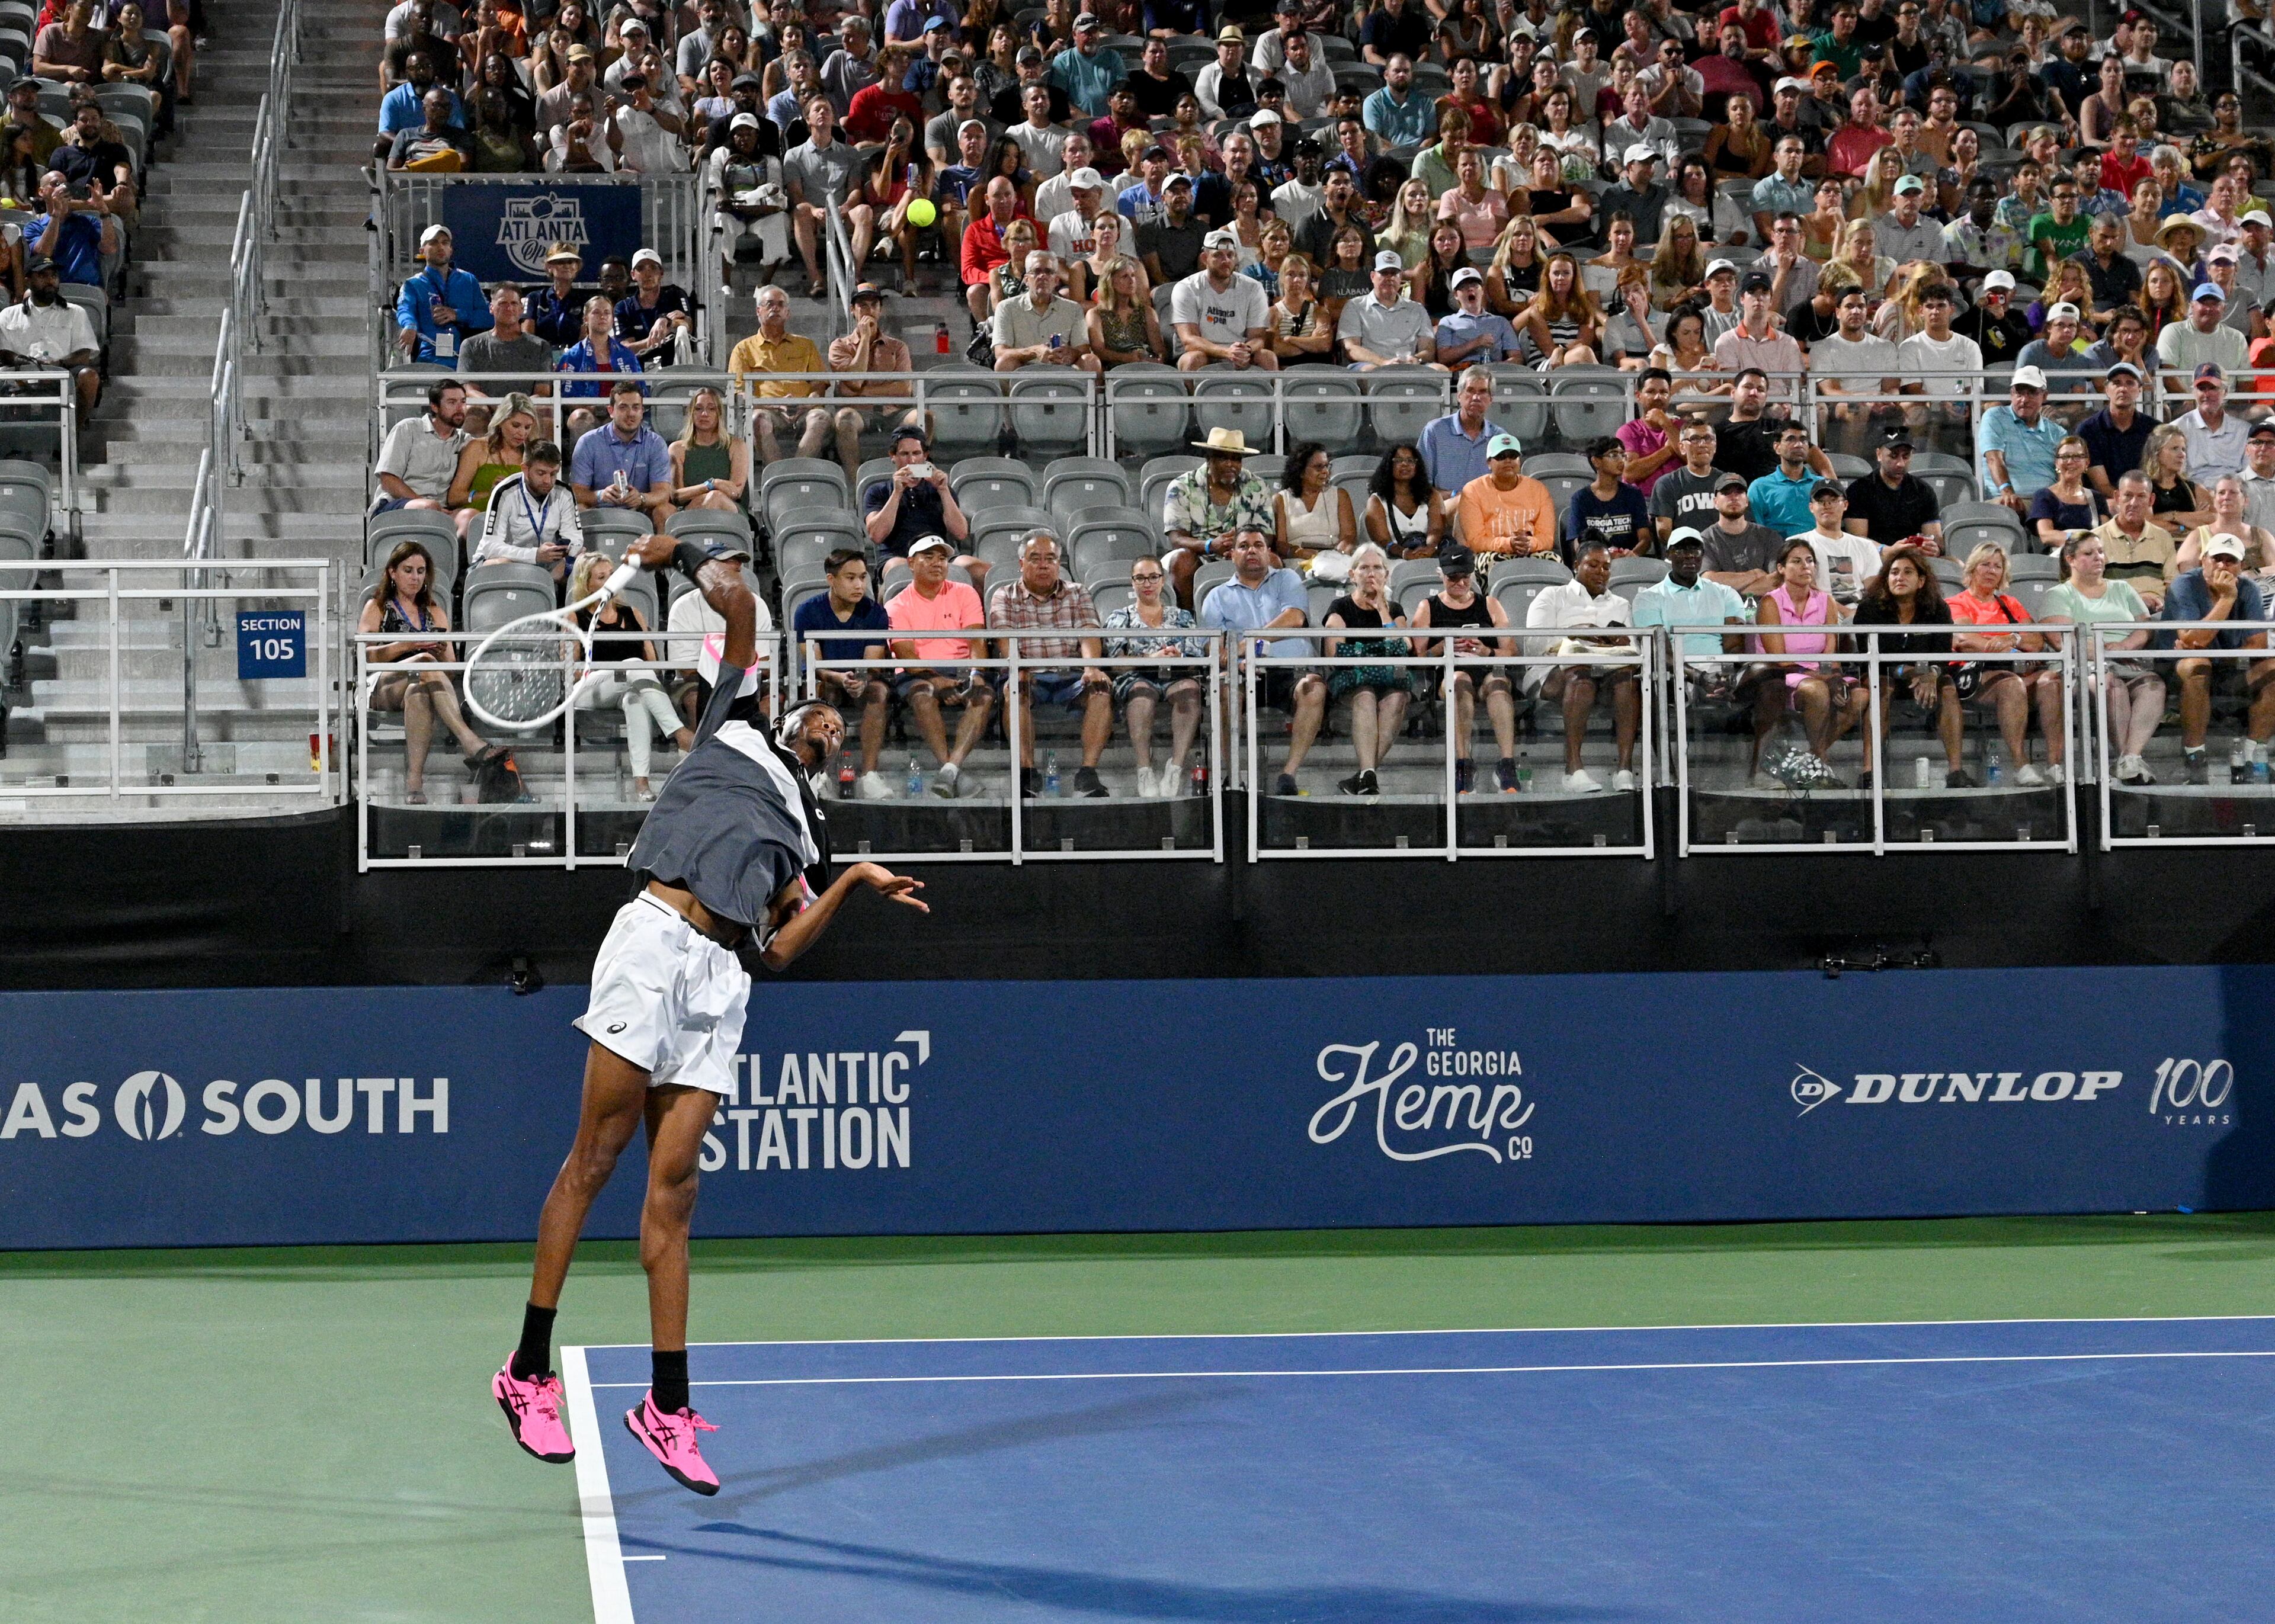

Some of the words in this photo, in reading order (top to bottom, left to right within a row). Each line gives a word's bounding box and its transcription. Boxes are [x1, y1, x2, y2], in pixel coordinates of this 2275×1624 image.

[502, 220, 584, 240] ATLANTA
[521, 237, 546, 264] Op
[1206, 306, 1235, 317] Atlanta
[1677, 492, 1715, 516] IOW
[1613, 516, 1631, 525] TECH
[241, 618, 300, 631] SECTION
[250, 638, 294, 660] 105
[1426, 1028, 1456, 1047] THE
[1427, 1051, 1522, 1076] GEORGIA
[719, 1051, 910, 1106] TLANTIC
[1797, 1083, 1824, 1096] D
[1845, 1071, 2123, 1103] DUNLOP
[2149, 1057, 2234, 1115] 100
[0, 1081, 101, 1139] AS
[201, 1077, 448, 1135] SOUTH
[1308, 1041, 1535, 1163] Hemp
[2165, 1115, 2230, 1125] YEARS
[698, 1107, 911, 1172] STATION
